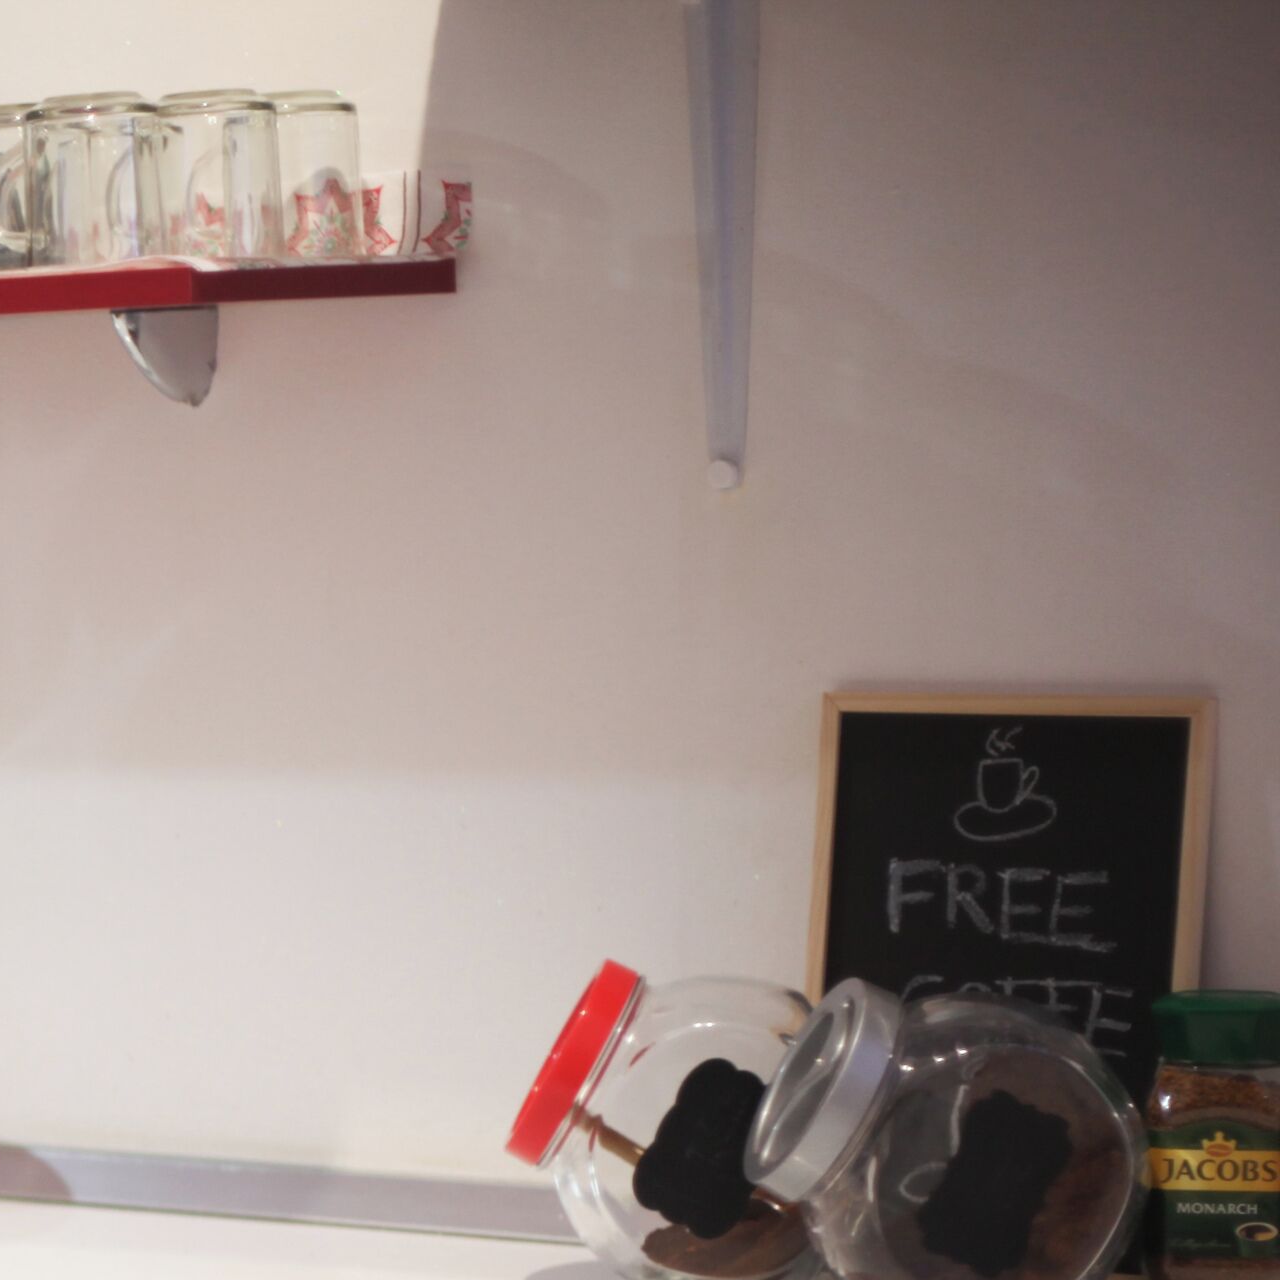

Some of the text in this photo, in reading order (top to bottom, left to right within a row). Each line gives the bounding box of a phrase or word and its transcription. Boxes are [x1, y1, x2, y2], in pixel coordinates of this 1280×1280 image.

[888, 857, 1117, 952] FREE
[1160, 1158, 1278, 1184] JACOBS
[1176, 1202, 1258, 1215] MONARCH
